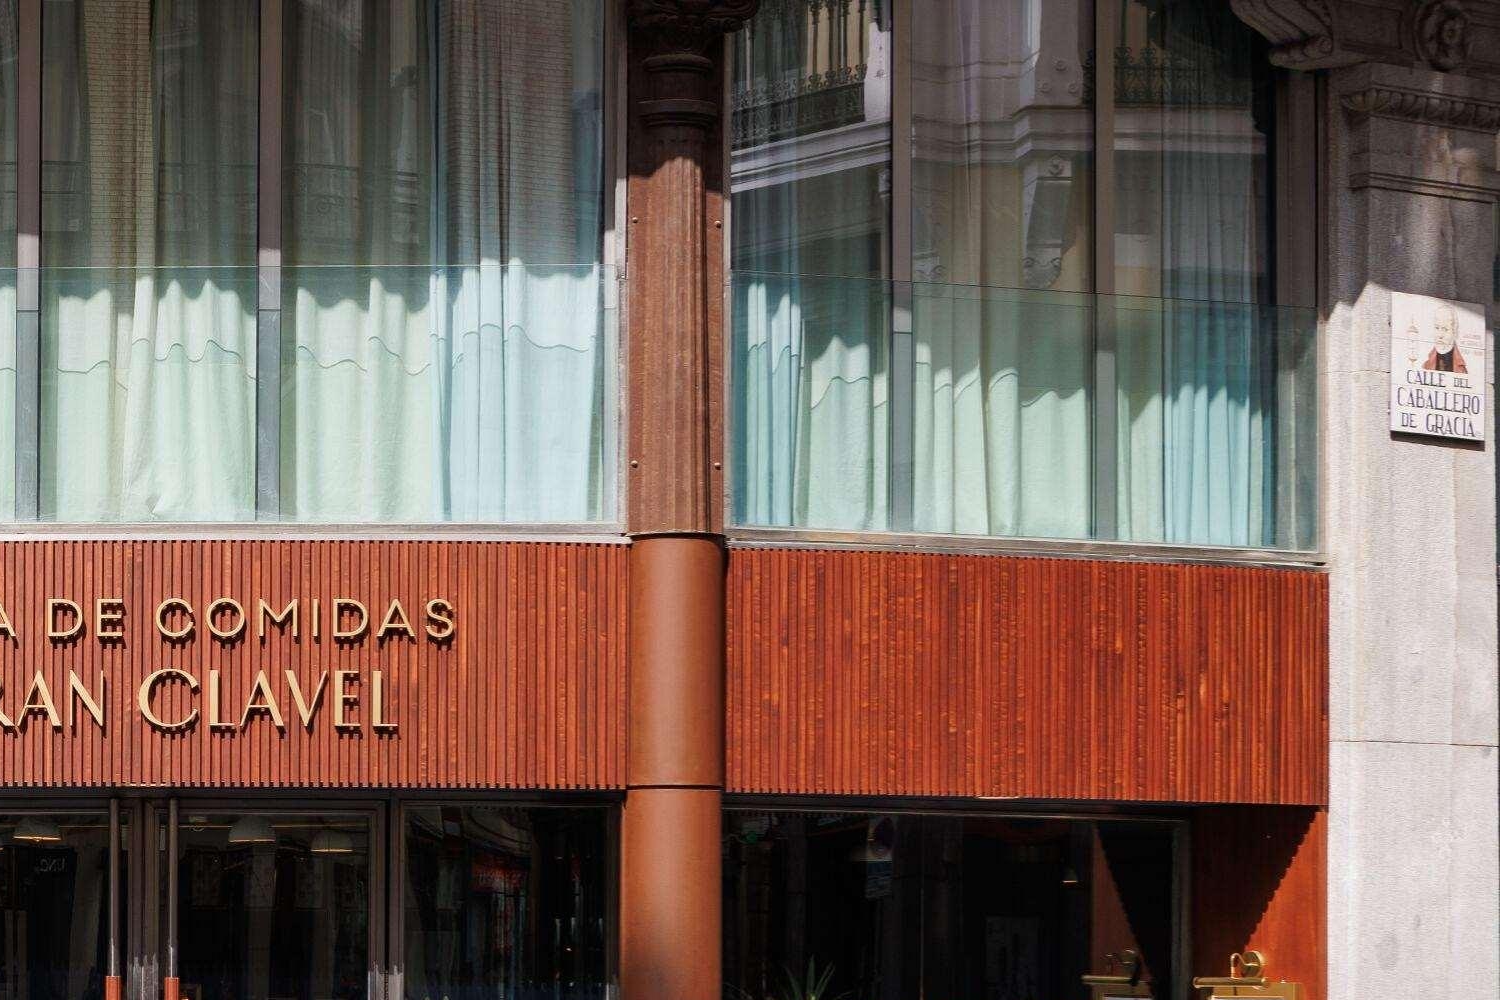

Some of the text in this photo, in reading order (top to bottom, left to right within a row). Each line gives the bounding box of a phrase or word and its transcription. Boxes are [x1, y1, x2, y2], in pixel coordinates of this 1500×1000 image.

[1406, 370, 1472, 389] CALLE DEL
[1397, 387, 1481, 415] CABALLERO
[1401, 412, 1476, 437] DE GRACIA
[47, 598, 126, 639] DE
[155, 597, 456, 640] COMIDAS
[138, 667, 401, 729] CLAVEL
